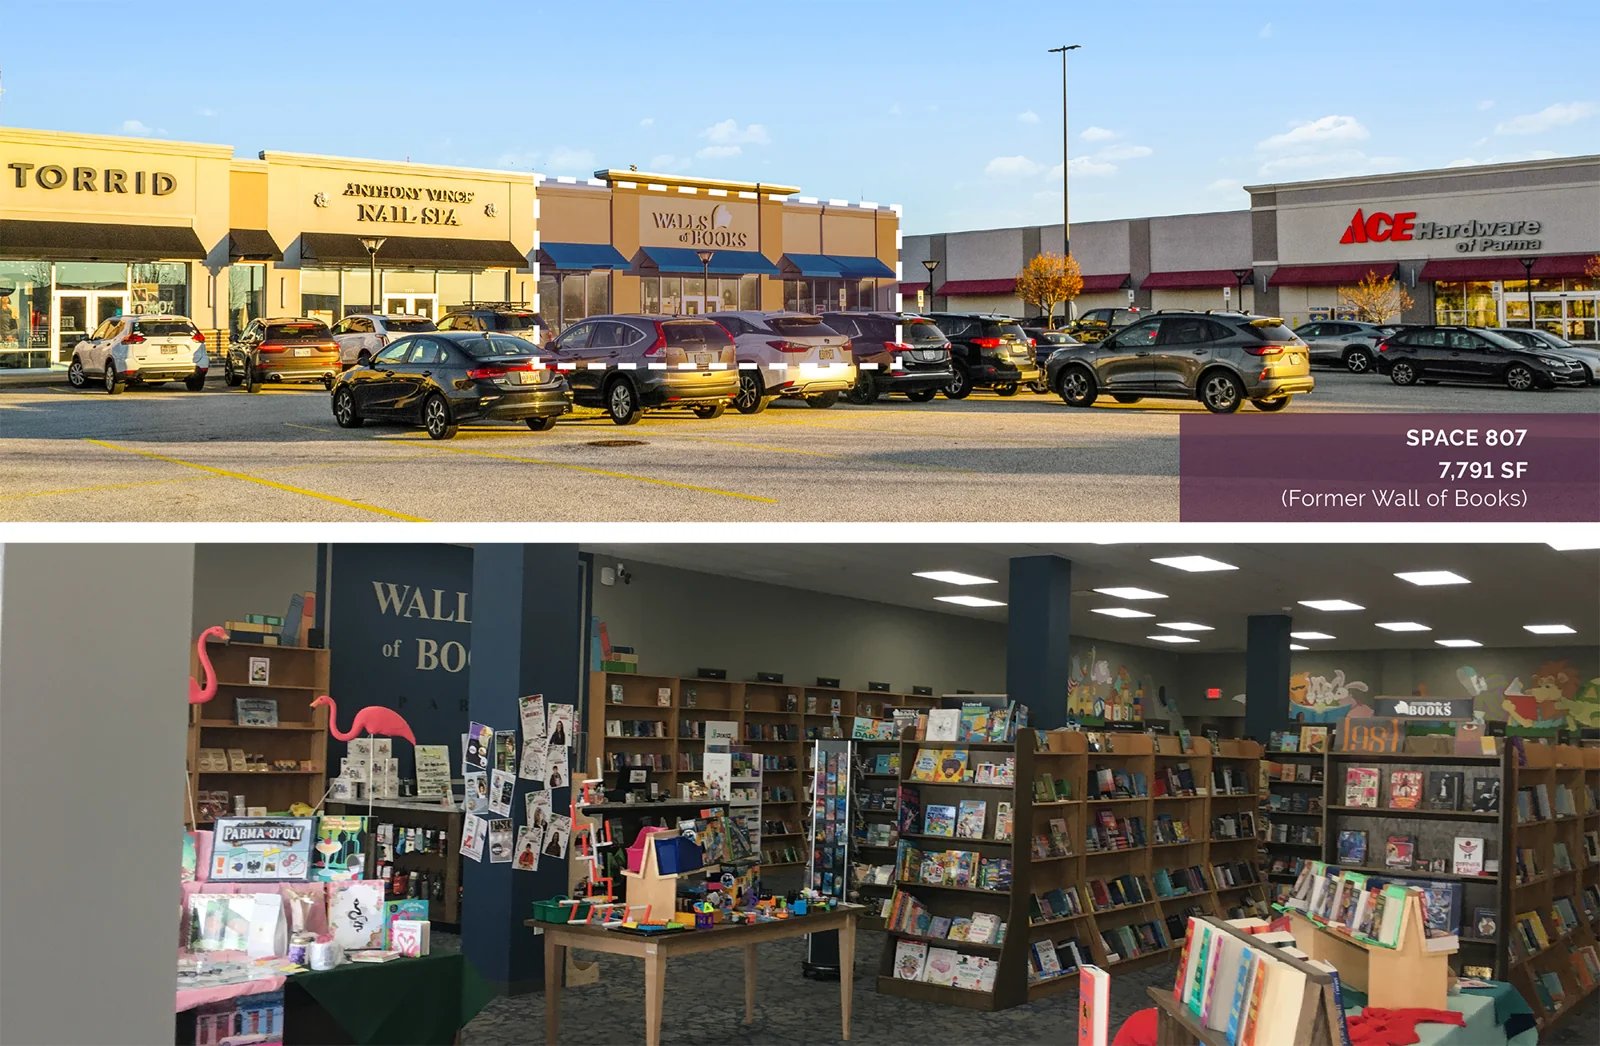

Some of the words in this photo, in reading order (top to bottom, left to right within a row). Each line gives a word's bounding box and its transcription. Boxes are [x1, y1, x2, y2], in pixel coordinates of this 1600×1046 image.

[8, 162, 178, 196] TORRID
[342, 182, 422, 200] ANTHONY
[425, 188, 475, 204] VINCE
[357, 203, 417, 224] NAIL
[421, 207, 463, 226] SPA
[652, 211, 708, 231] WALLS
[1339, 208, 1416, 244] ACE
[1414, 220, 1542, 240] Hardware
[679, 232, 689, 243] of
[691, 230, 748, 248] BOOKS
[1456, 237, 1475, 253] of
[1479, 238, 1542, 252] Parma
[372, 581, 472, 624] WALL
[382, 639, 402, 657] of
[416, 638, 472, 673] BO
[1409, 705, 1452, 716] BOOKS
